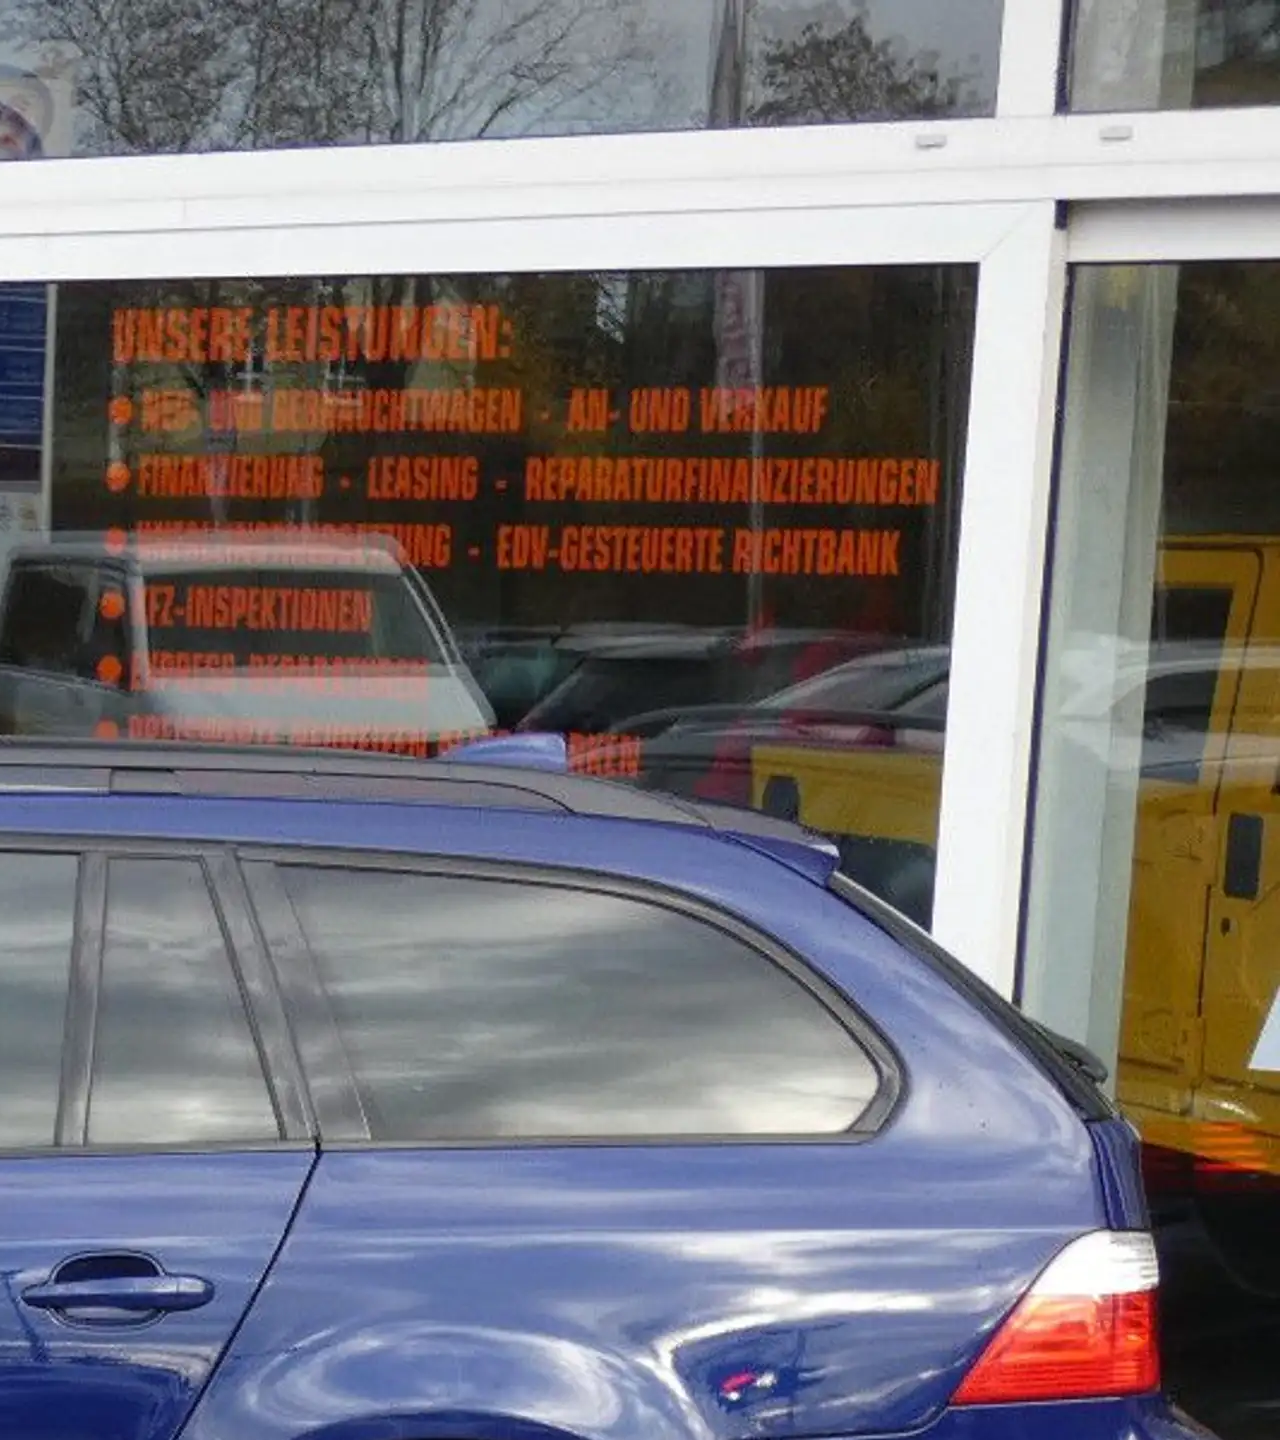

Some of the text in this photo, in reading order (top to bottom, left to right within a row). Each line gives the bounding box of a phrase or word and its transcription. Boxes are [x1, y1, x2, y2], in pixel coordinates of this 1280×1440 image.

[113, 305, 513, 362] UNSERE LEISTUNGEN:
[209, 389, 265, 432] UND
[273, 388, 521, 432] GEBRAUCHTWAGEN
[567, 387, 620, 432] AN-
[628, 388, 690, 433] UND
[700, 386, 829, 433] VERKAUF
[140, 454, 324, 498] FINANZIERUNG
[368, 456, 479, 500] LEASING
[525, 456, 939, 505] REPARATURFINANZIERUNGEN
[496, 524, 725, 573] EDV-GESTEUERTE
[732, 528, 900, 576] RICHTBANK
